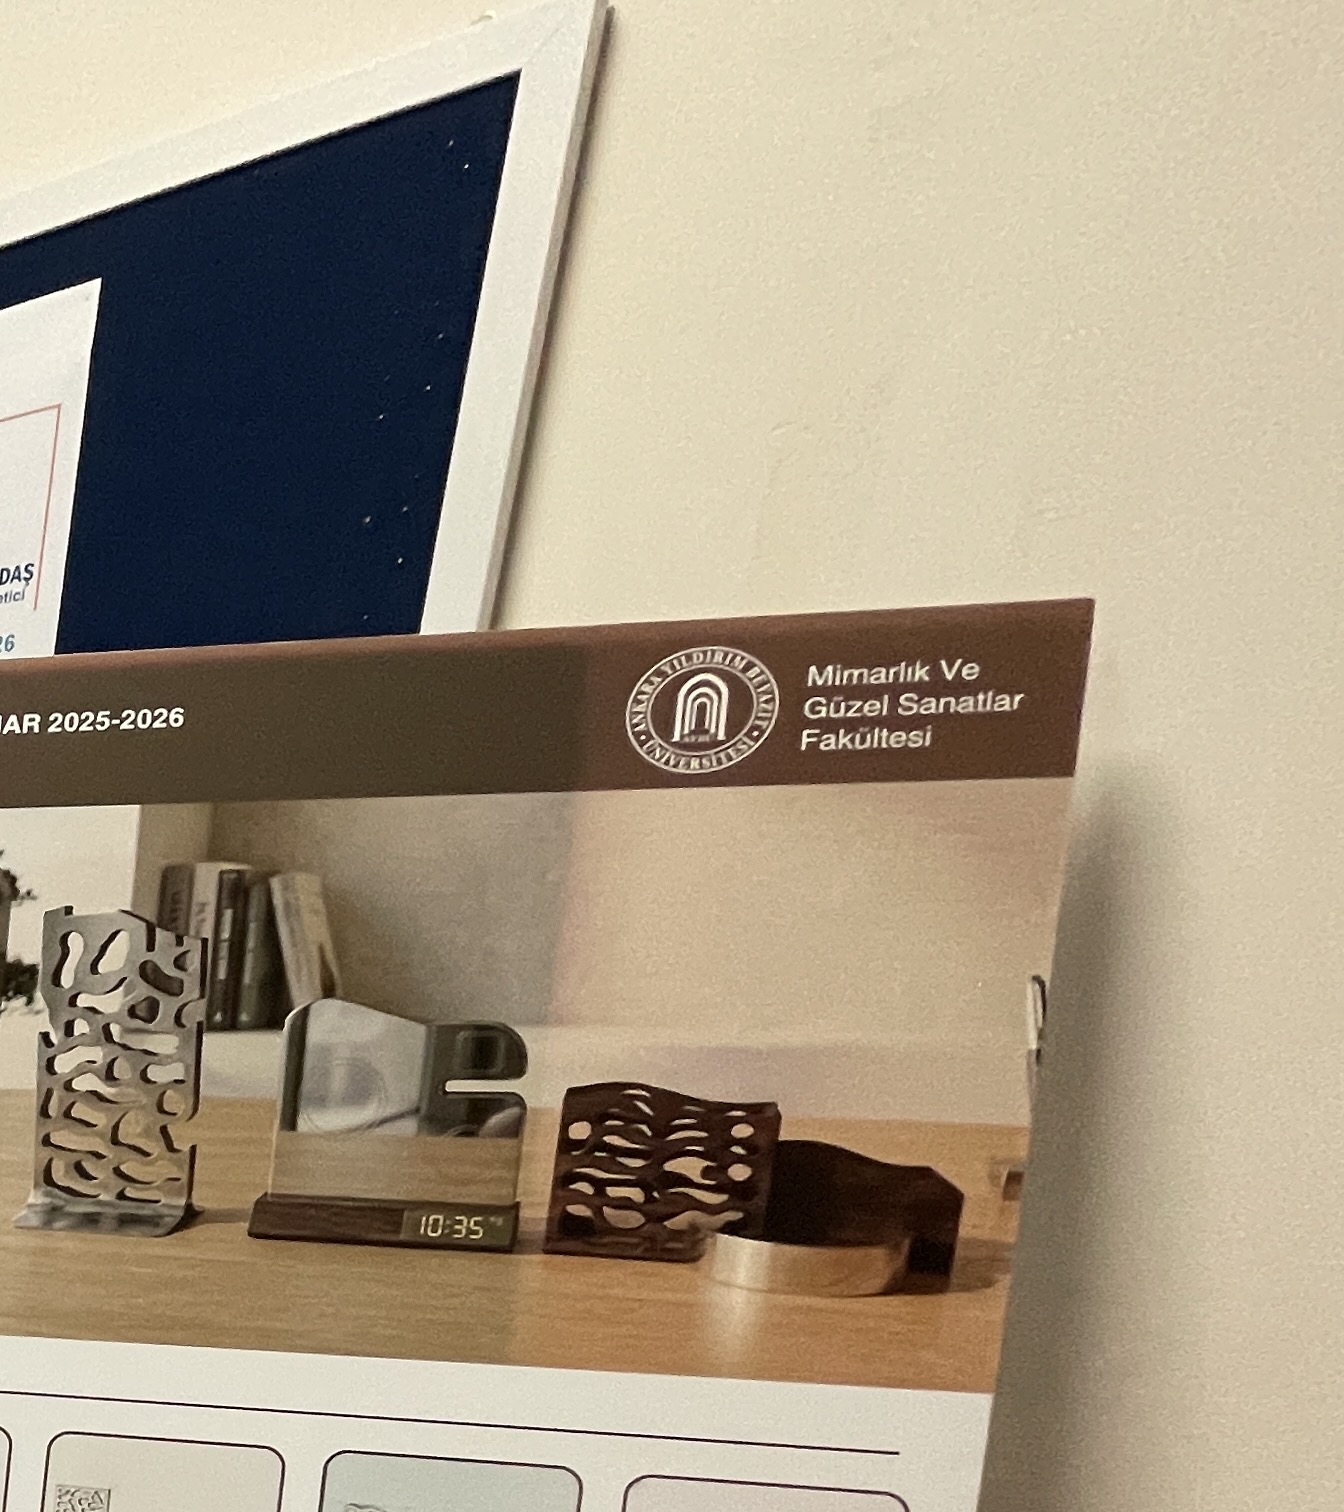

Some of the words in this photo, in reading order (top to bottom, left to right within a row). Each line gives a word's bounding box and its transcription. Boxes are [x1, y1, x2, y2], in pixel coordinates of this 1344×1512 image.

[806, 660, 931, 687] Mimarlık
[940, 658, 980, 682] Ve
[803, 694, 889, 719] Güzel
[897, 688, 1025, 716] Sanatlar
[47, 707, 185, 733] 2025-2026
[800, 725, 933, 751] Fakültesi
[420, 1214, 485, 1240] 10:35
